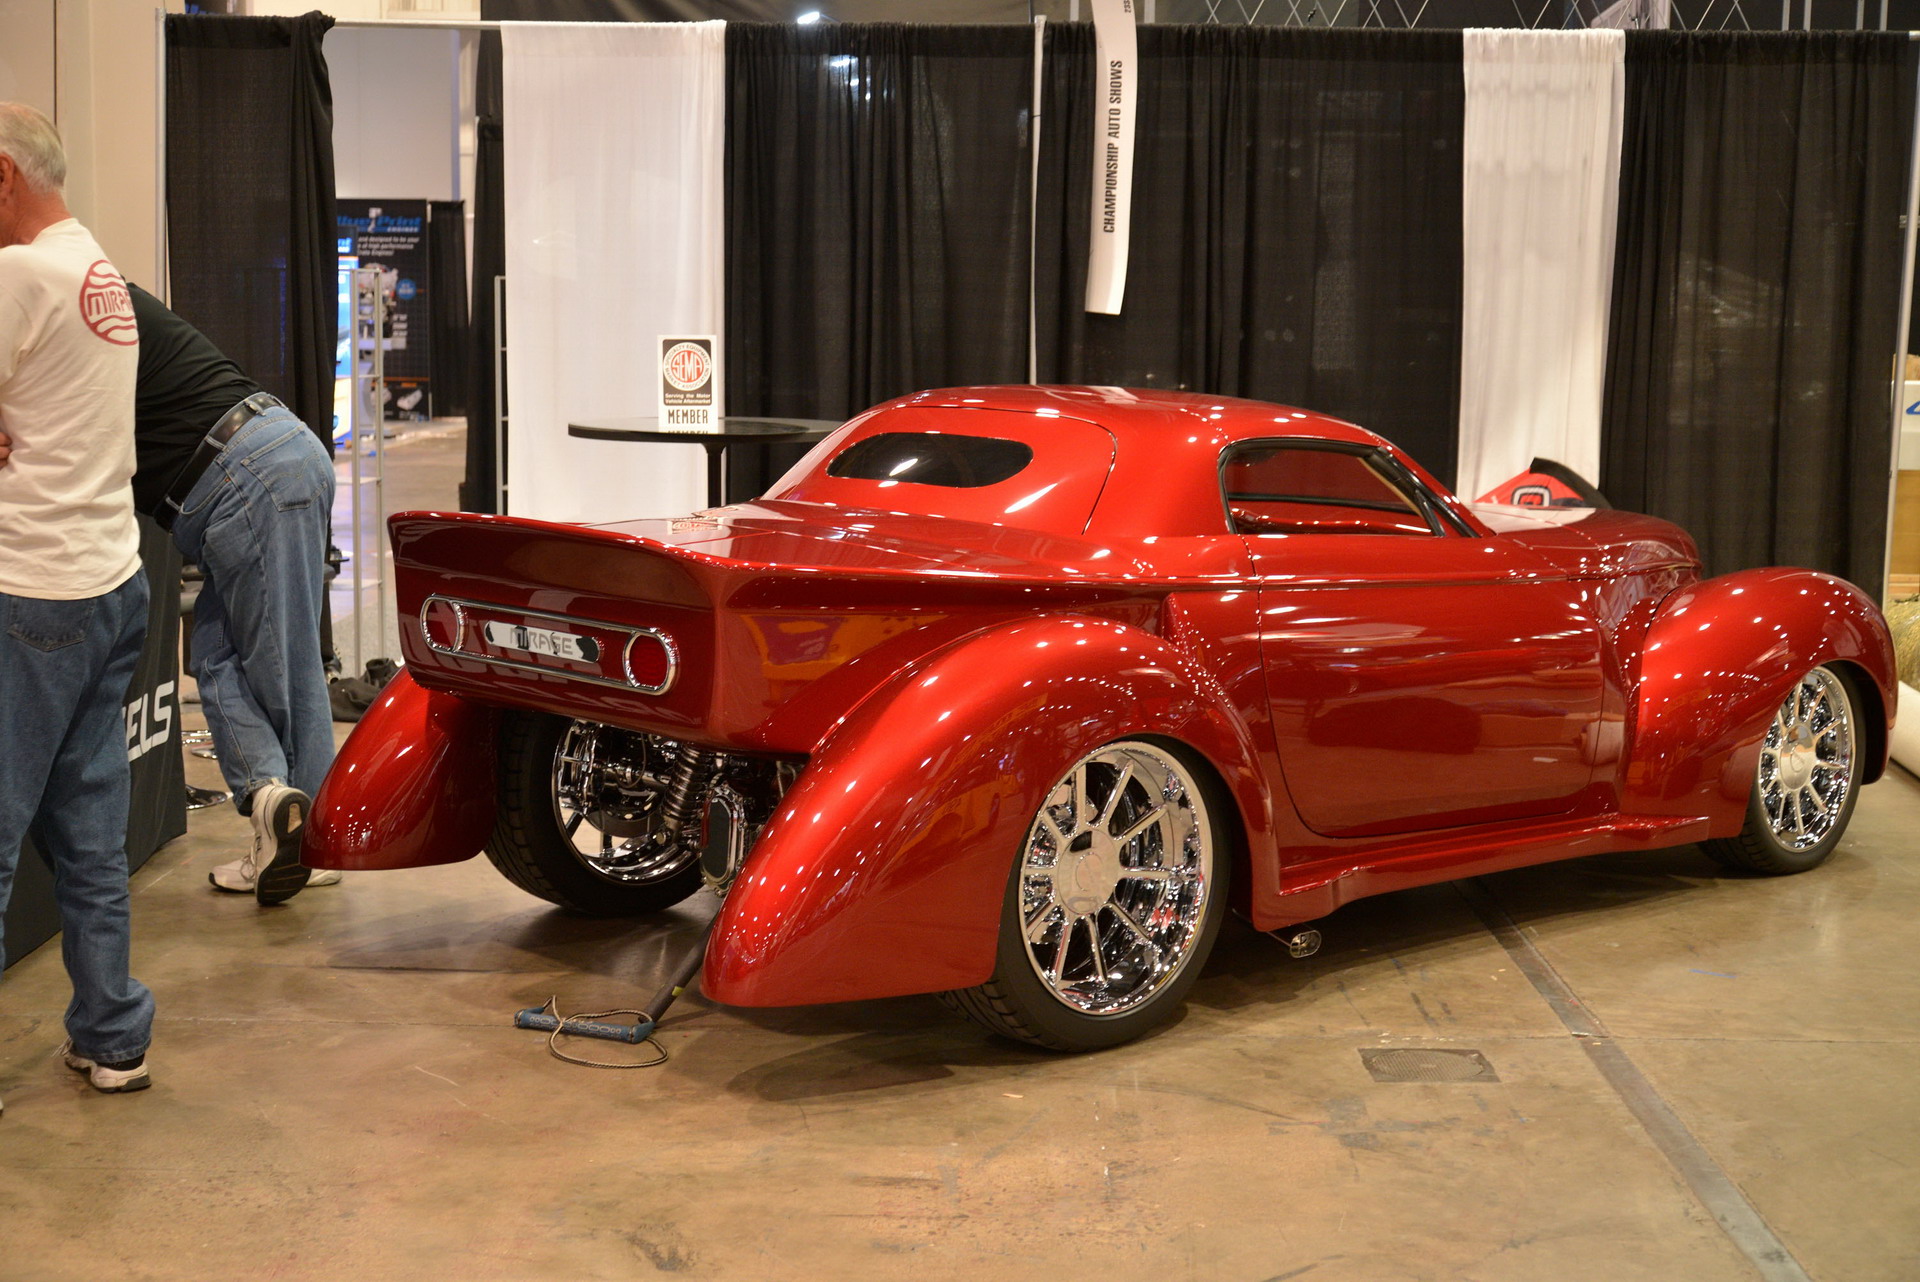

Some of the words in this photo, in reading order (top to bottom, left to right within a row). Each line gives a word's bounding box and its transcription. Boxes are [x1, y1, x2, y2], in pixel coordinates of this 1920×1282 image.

[1109, 60, 1122, 104] SHOWS
[1107, 107, 1121, 139] AUTO
[1103, 143, 1119, 233] CHAMPIONSHIP
[671, 350, 704, 383] SEMA
[668, 409, 709, 424] MEMBER
[121, 680, 175, 762] ELS
